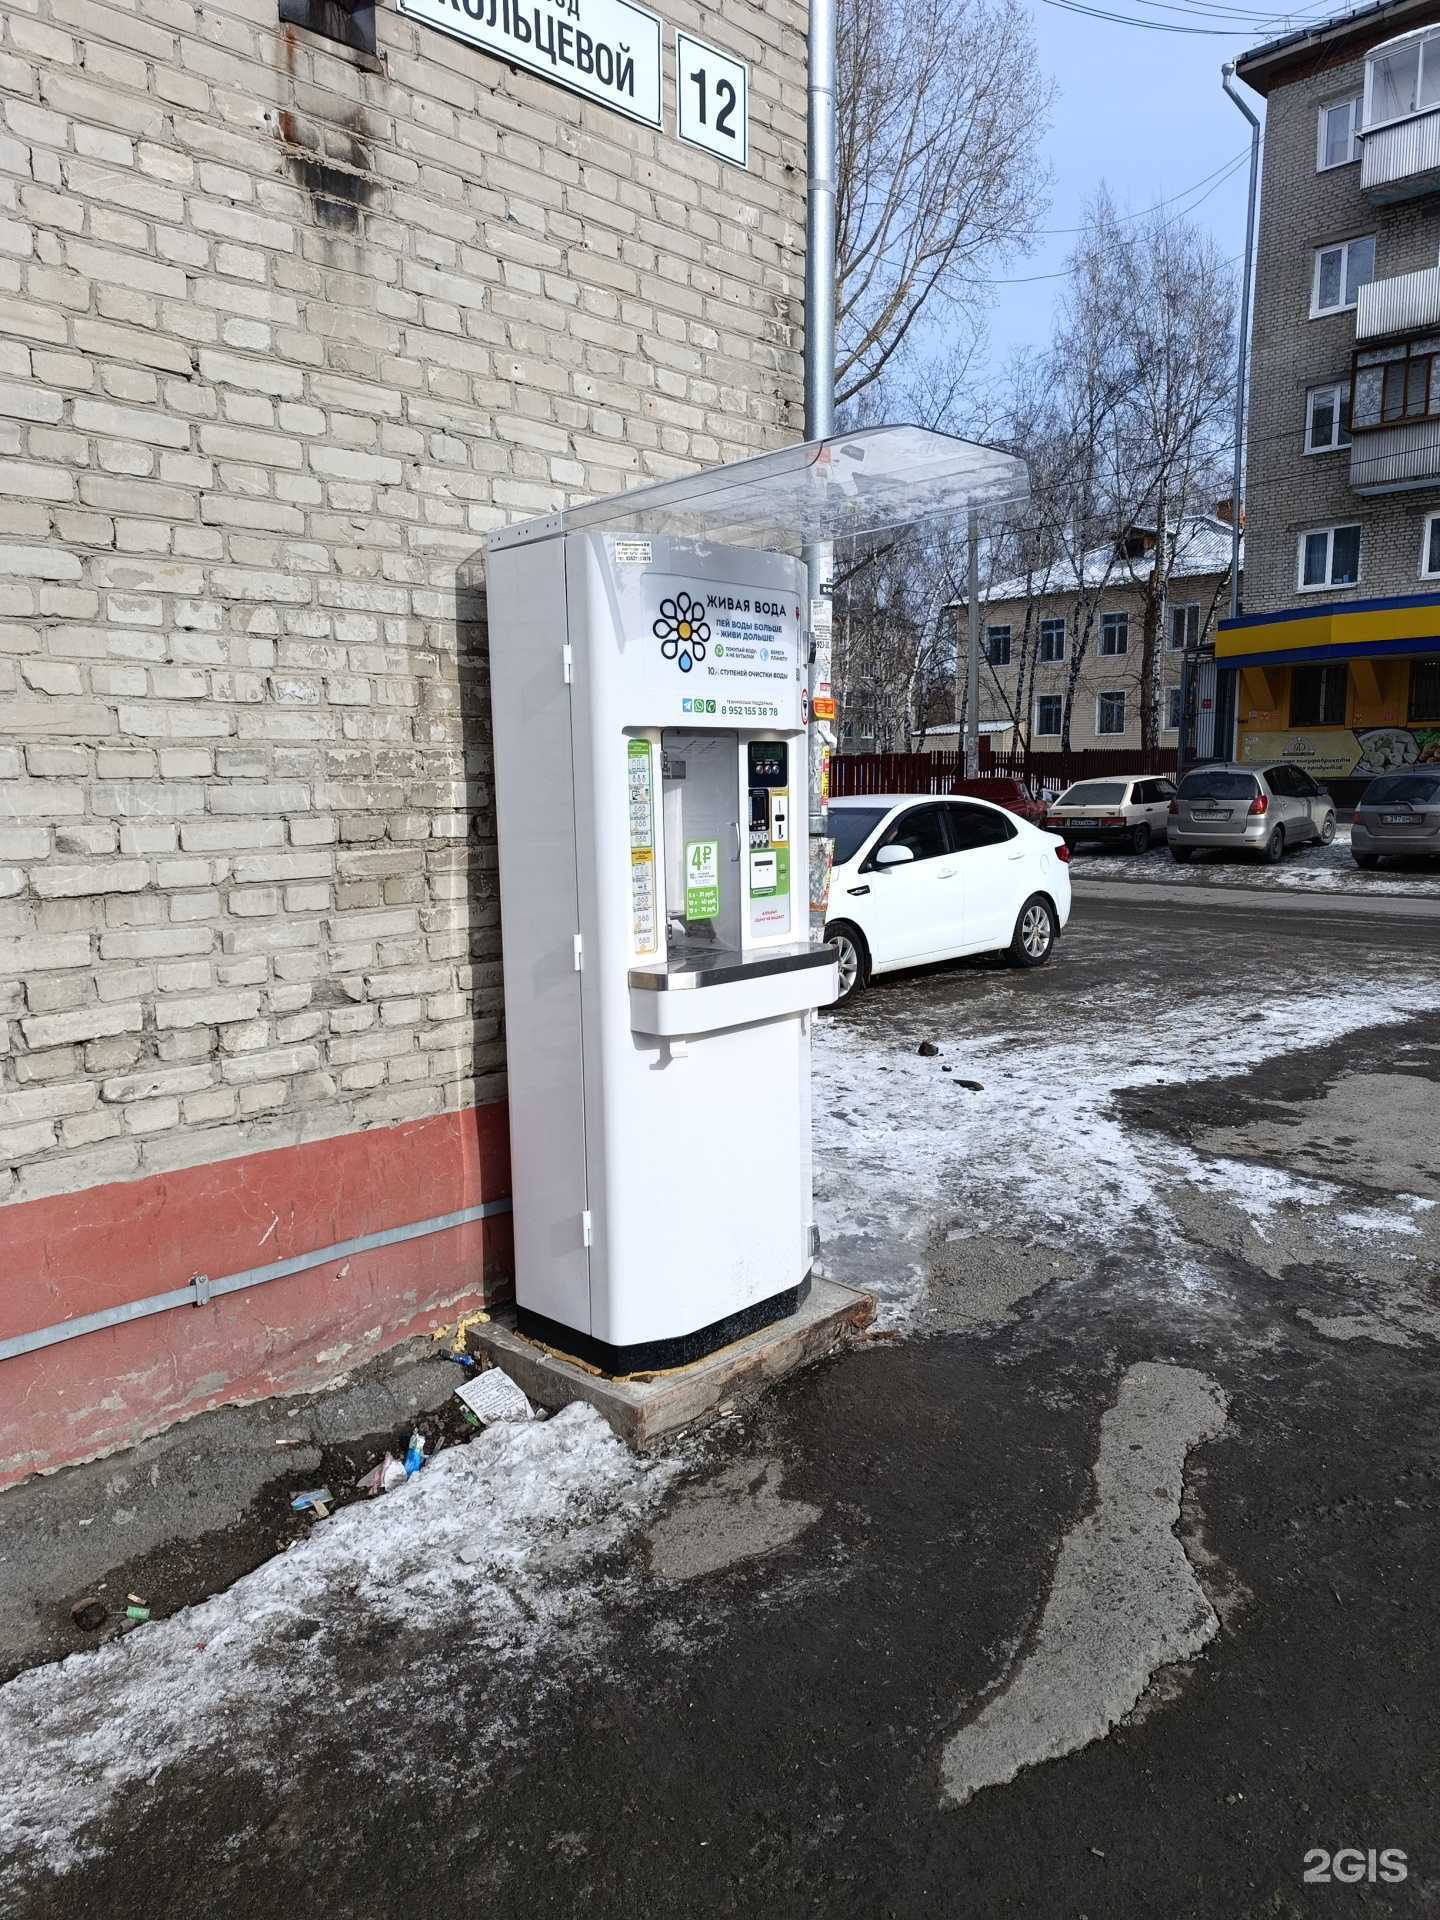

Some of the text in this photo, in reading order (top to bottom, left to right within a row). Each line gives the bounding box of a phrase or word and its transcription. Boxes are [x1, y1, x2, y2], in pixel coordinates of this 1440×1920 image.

[439, 0, 635, 98] ЛЬЦЕВОЙ
[690, 68, 737, 139] 12
[707, 594, 787, 617] ЖИВАЯ ВОДА
[716, 619, 783, 633] ПЕЙ ВОДЫ БОЛЬШЕ
[720, 631, 742, 639] ЖИВИ
[721, 706, 778, 716] 8 952 155 38 78
